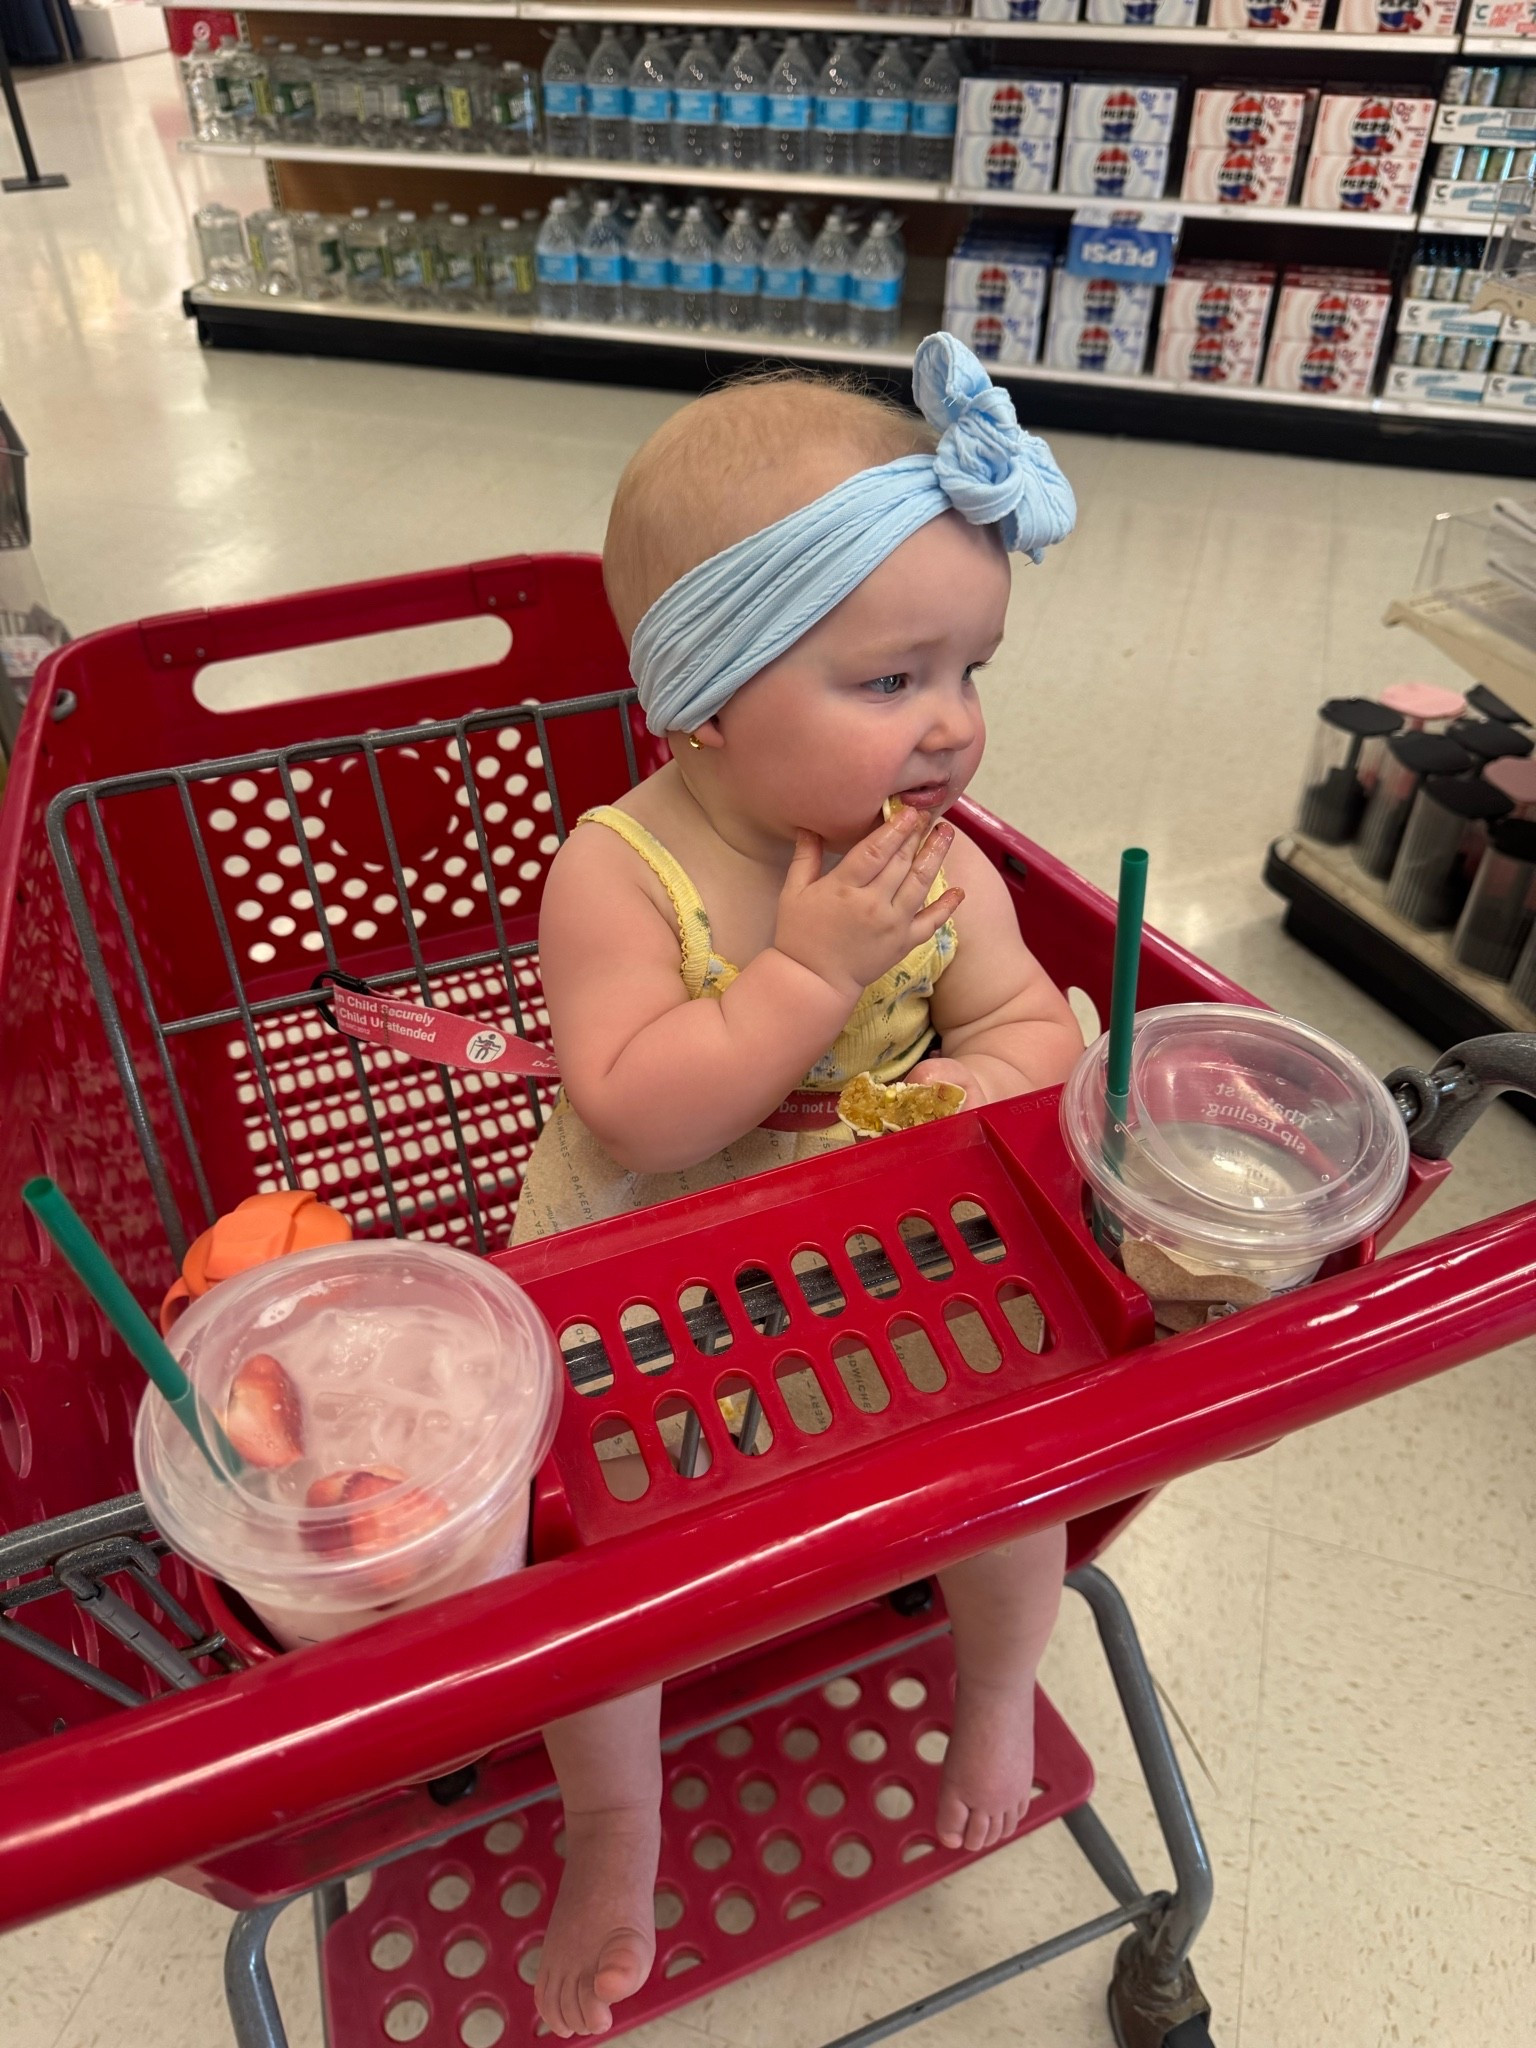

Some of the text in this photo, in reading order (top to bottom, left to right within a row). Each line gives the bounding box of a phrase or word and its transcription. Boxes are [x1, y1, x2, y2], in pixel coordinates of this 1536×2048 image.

[1353, 120, 1394, 134] PEPSI
[1081, 241, 1158, 268] PEPSI
[339, 1008, 437, 1043] Child Unattended
[347, 996, 378, 1013] Child
[381, 1004, 435, 1027] Securely
[779, 1101, 798, 1113] Do
[801, 1102, 824, 1113] not
[570, 1175, 594, 1222] BAKERY
